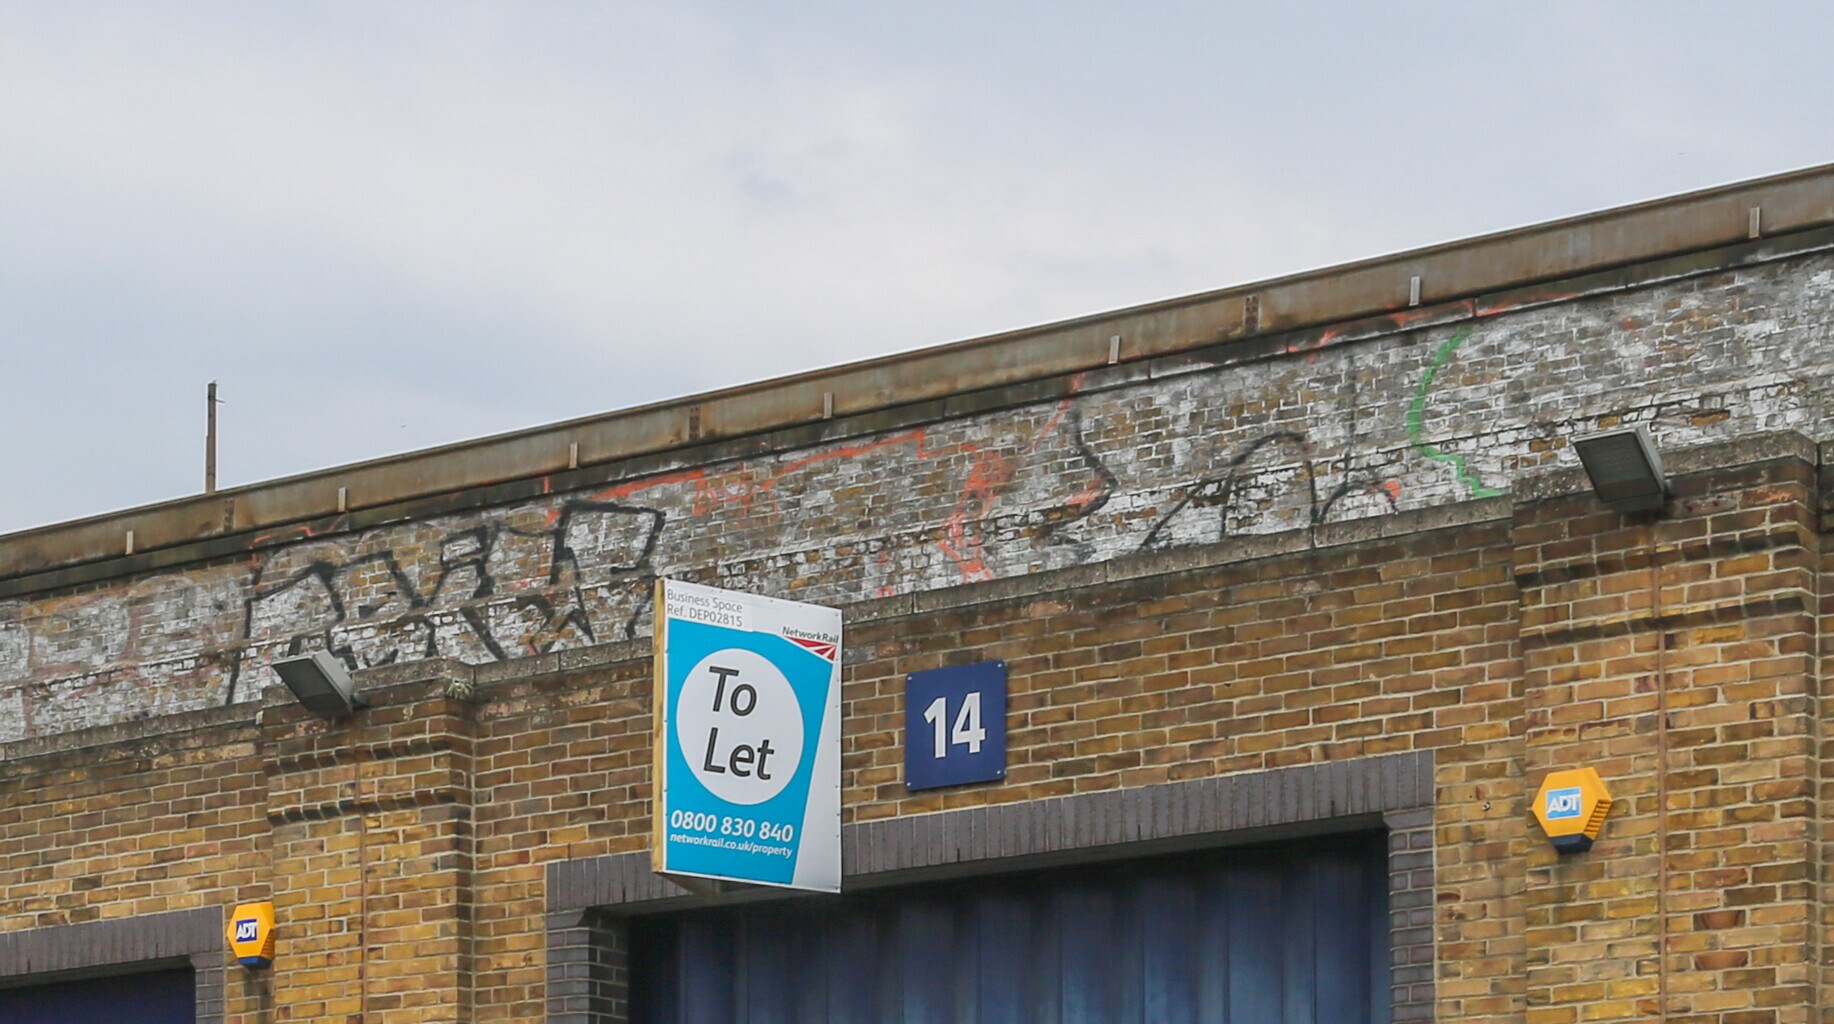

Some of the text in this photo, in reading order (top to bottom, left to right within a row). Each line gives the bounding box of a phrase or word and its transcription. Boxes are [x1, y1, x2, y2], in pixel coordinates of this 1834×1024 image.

[667, 589, 743, 613] Business Space
[667, 603, 743, 627] Ref. DEP02815
[709, 666, 757, 717] To
[924, 692, 985, 758] 14
[703, 727, 775, 780] Let
[1547, 794, 1580, 814] ADT
[671, 809, 794, 843] 0800 830 840
[670, 833, 793, 859] networkrail.co.uk/property
[236, 921, 257, 940] ADT
